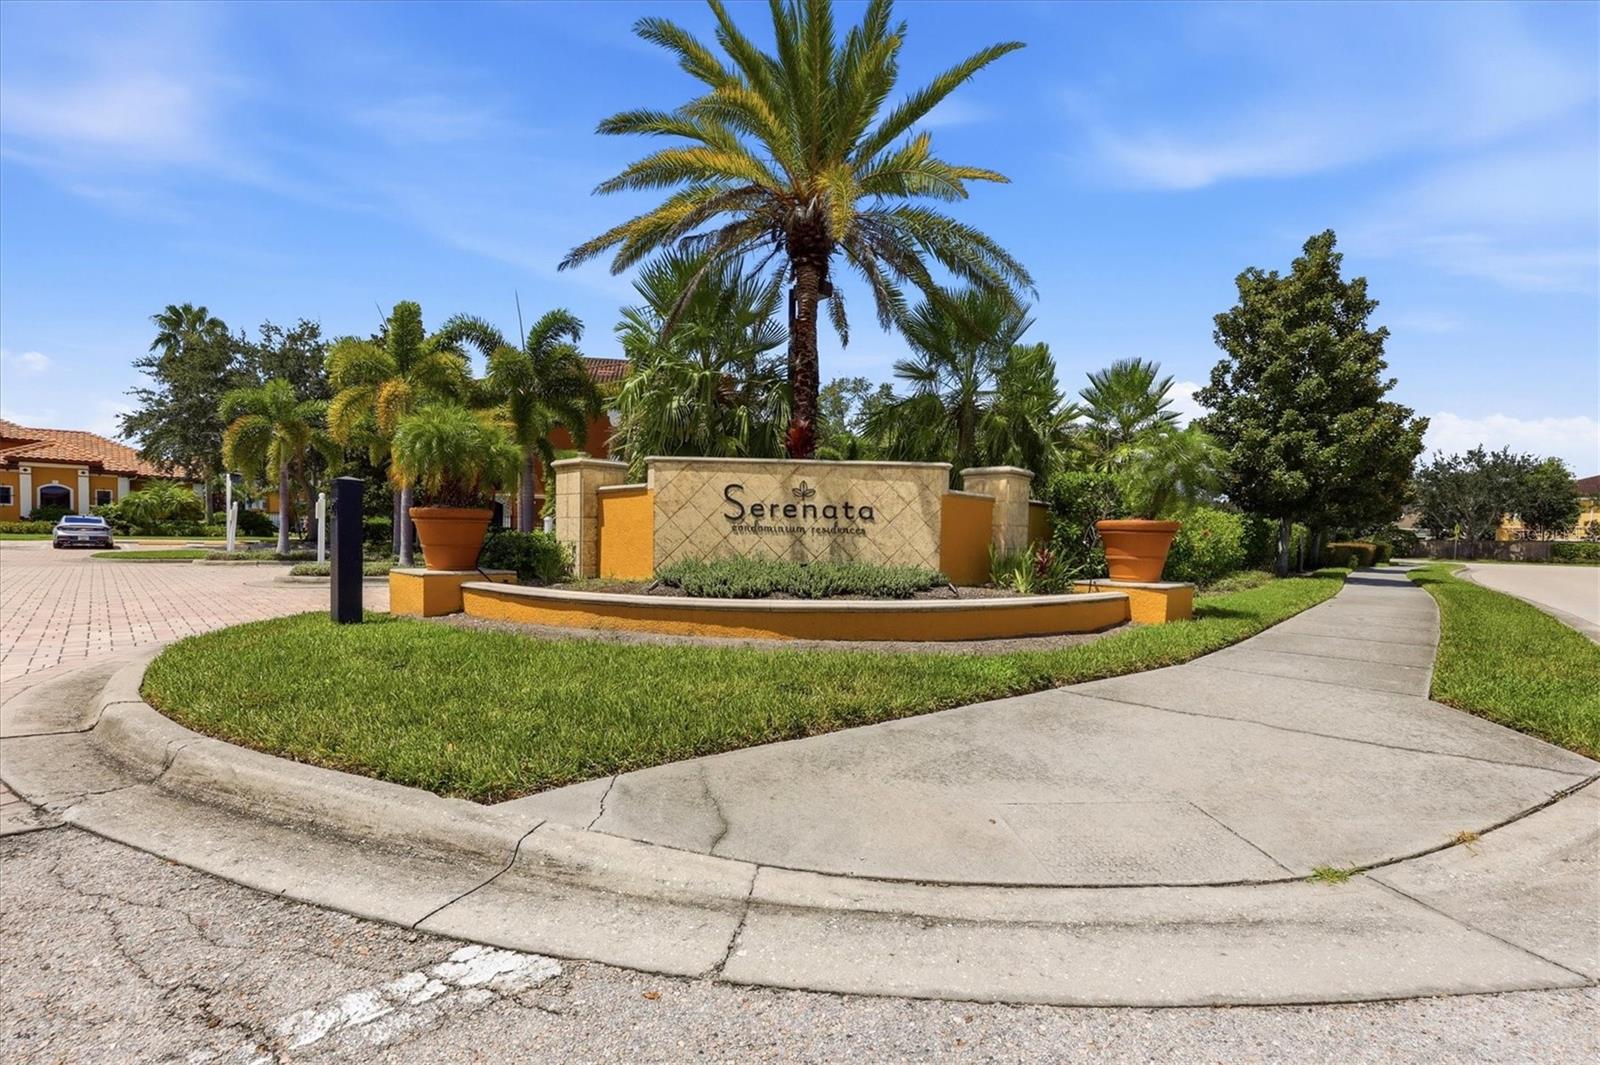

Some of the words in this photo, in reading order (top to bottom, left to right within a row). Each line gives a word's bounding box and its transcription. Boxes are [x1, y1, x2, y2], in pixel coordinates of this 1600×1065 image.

[723, 483, 875, 521] Serenata
[732, 520, 806, 535] condominium
[811, 521, 866, 535] residences
